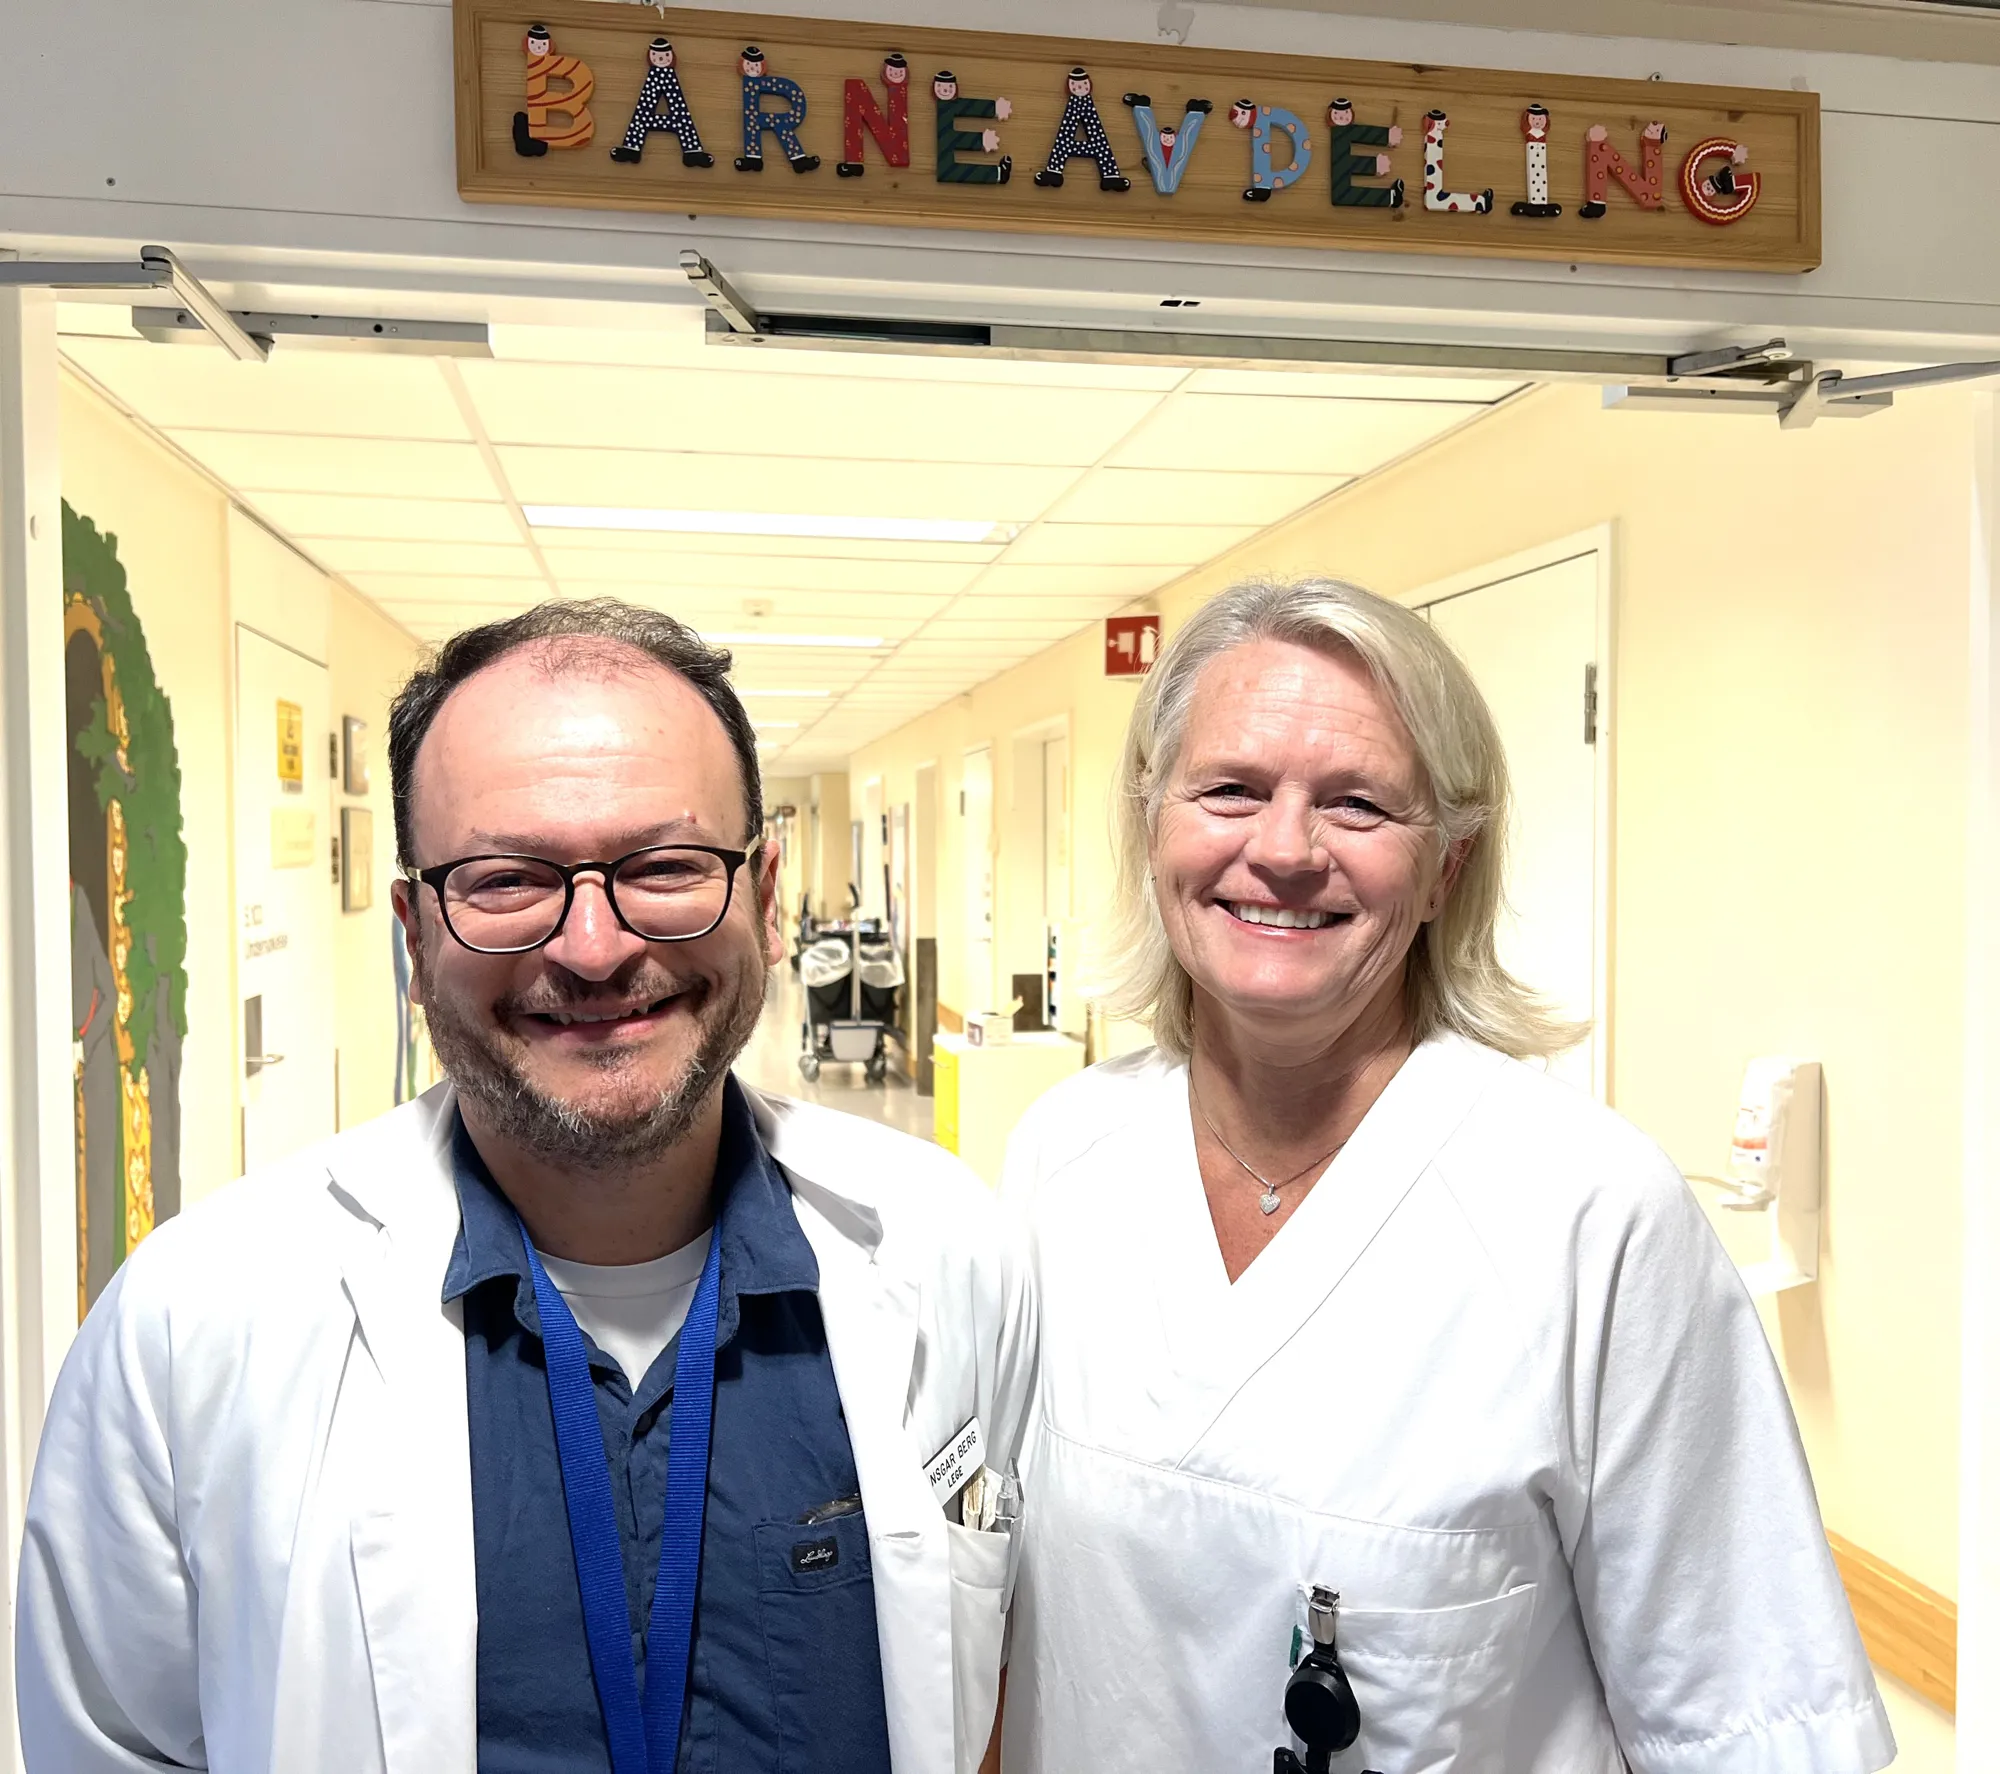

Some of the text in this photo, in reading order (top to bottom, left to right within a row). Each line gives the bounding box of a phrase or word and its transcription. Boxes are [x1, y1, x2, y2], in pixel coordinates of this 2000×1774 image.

[512, 23, 1762, 225] BARNEAVDELING
[929, 1430, 977, 1487] NSGAR BERG
[947, 1465, 964, 1488] LEGE
